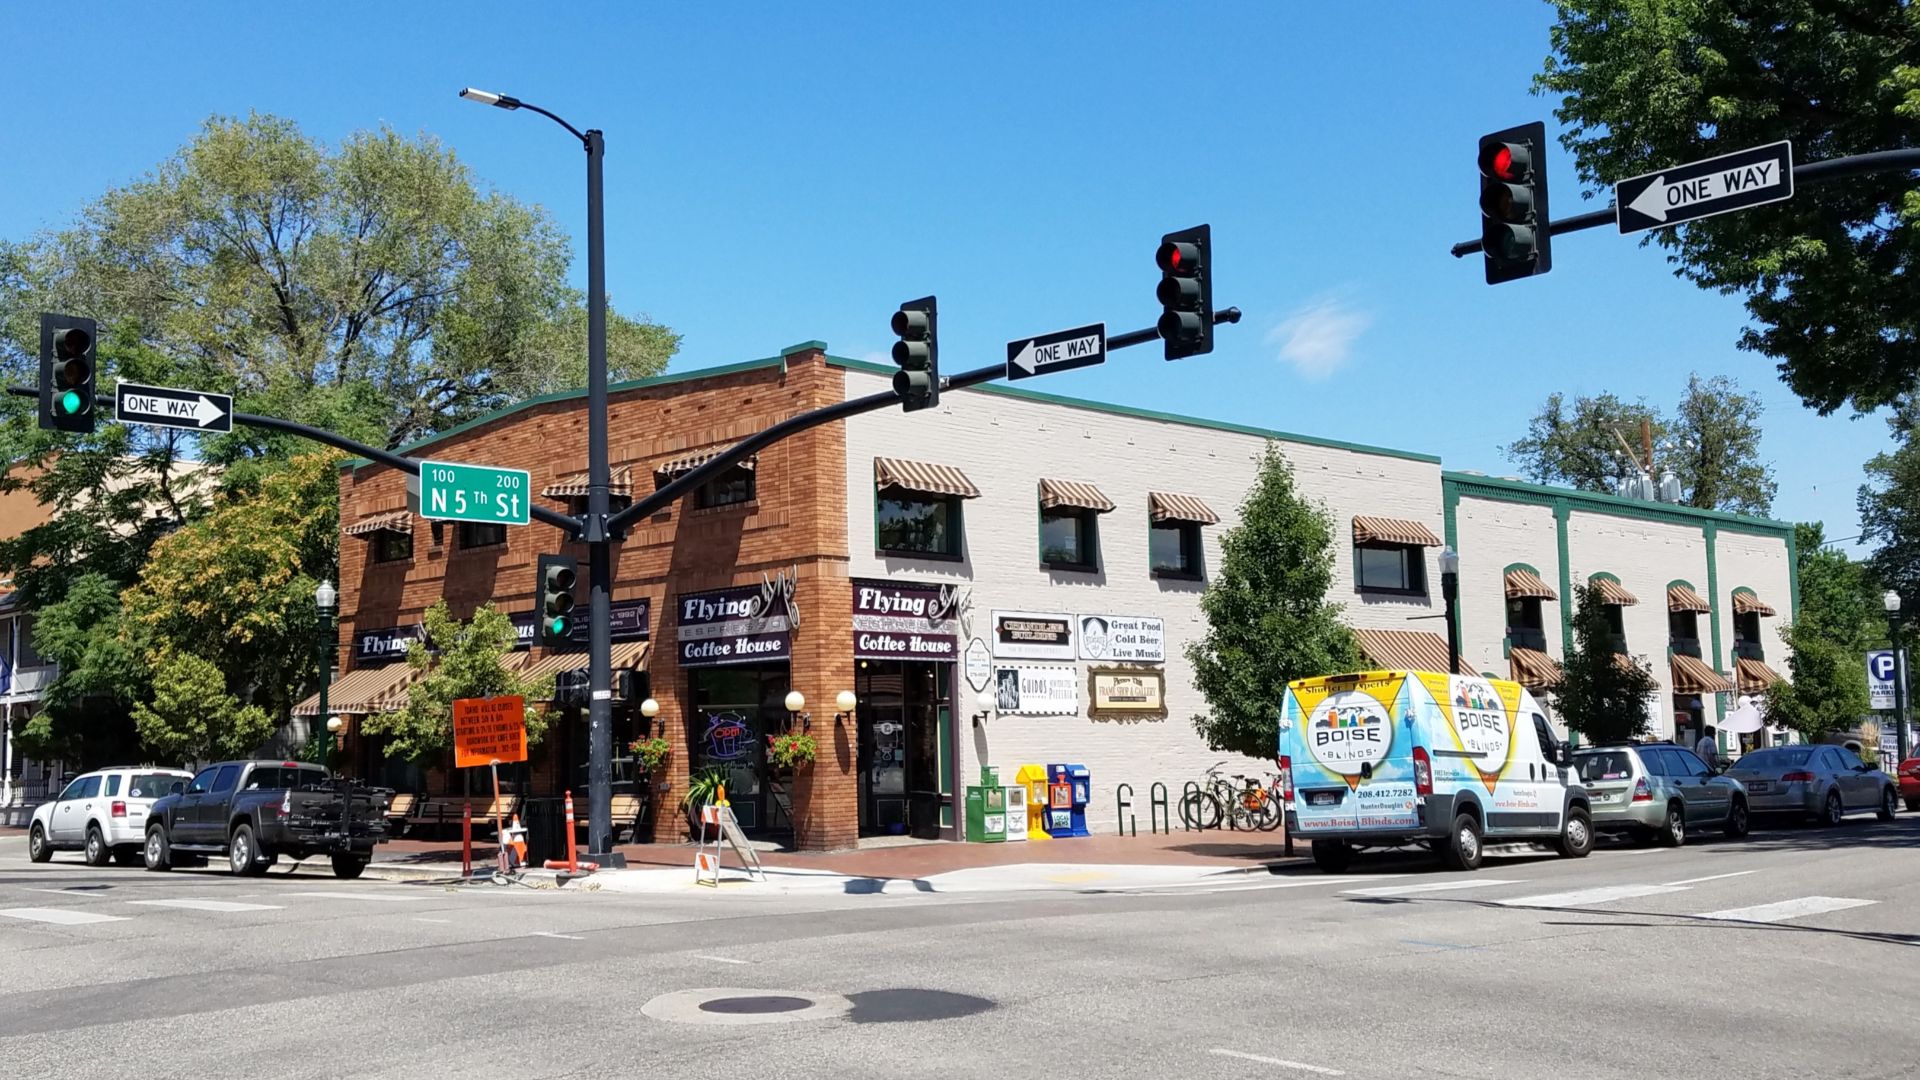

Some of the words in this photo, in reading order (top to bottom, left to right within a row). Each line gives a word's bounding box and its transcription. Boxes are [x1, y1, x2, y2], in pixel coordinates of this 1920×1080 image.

[1667, 177, 1712, 206] ONE
[1723, 163, 1772, 193] WAY
[1035, 345, 1061, 363] ONE
[1067, 337, 1096, 357] WAY
[128, 396, 158, 412] ONE
[167, 400, 198, 416] WAY
[432, 469, 455, 483] 100
[496, 475, 520, 489] 200
[431, 487, 447, 512] N
[496, 493, 520, 518] St
[684, 597, 752, 620] Flying
[859, 587, 926, 616] Flying
[1111, 620, 1138, 630] Great
[1141, 621, 1161, 631] Food
[362, 633, 413, 654] Flying
[684, 641, 731, 658] Coffee
[734, 638, 782, 654] House
[859, 633, 906, 651] Coffee
[909, 635, 952, 653] House
[1115, 634, 1136, 644] Cold
[1140, 635, 1159, 645] Beer
[1112, 648, 1132, 658] Live
[1135, 648, 1162, 659] Music
[1305, 685, 1343, 694] Shutter
[1459, 712, 1504, 735] BOISE
[1316, 728, 1381, 747] BOISE
[1471, 739, 1500, 752] BLINDS
[1327, 749, 1373, 760] BLINDS
[1357, 788, 1413, 799] 208.412.7282
